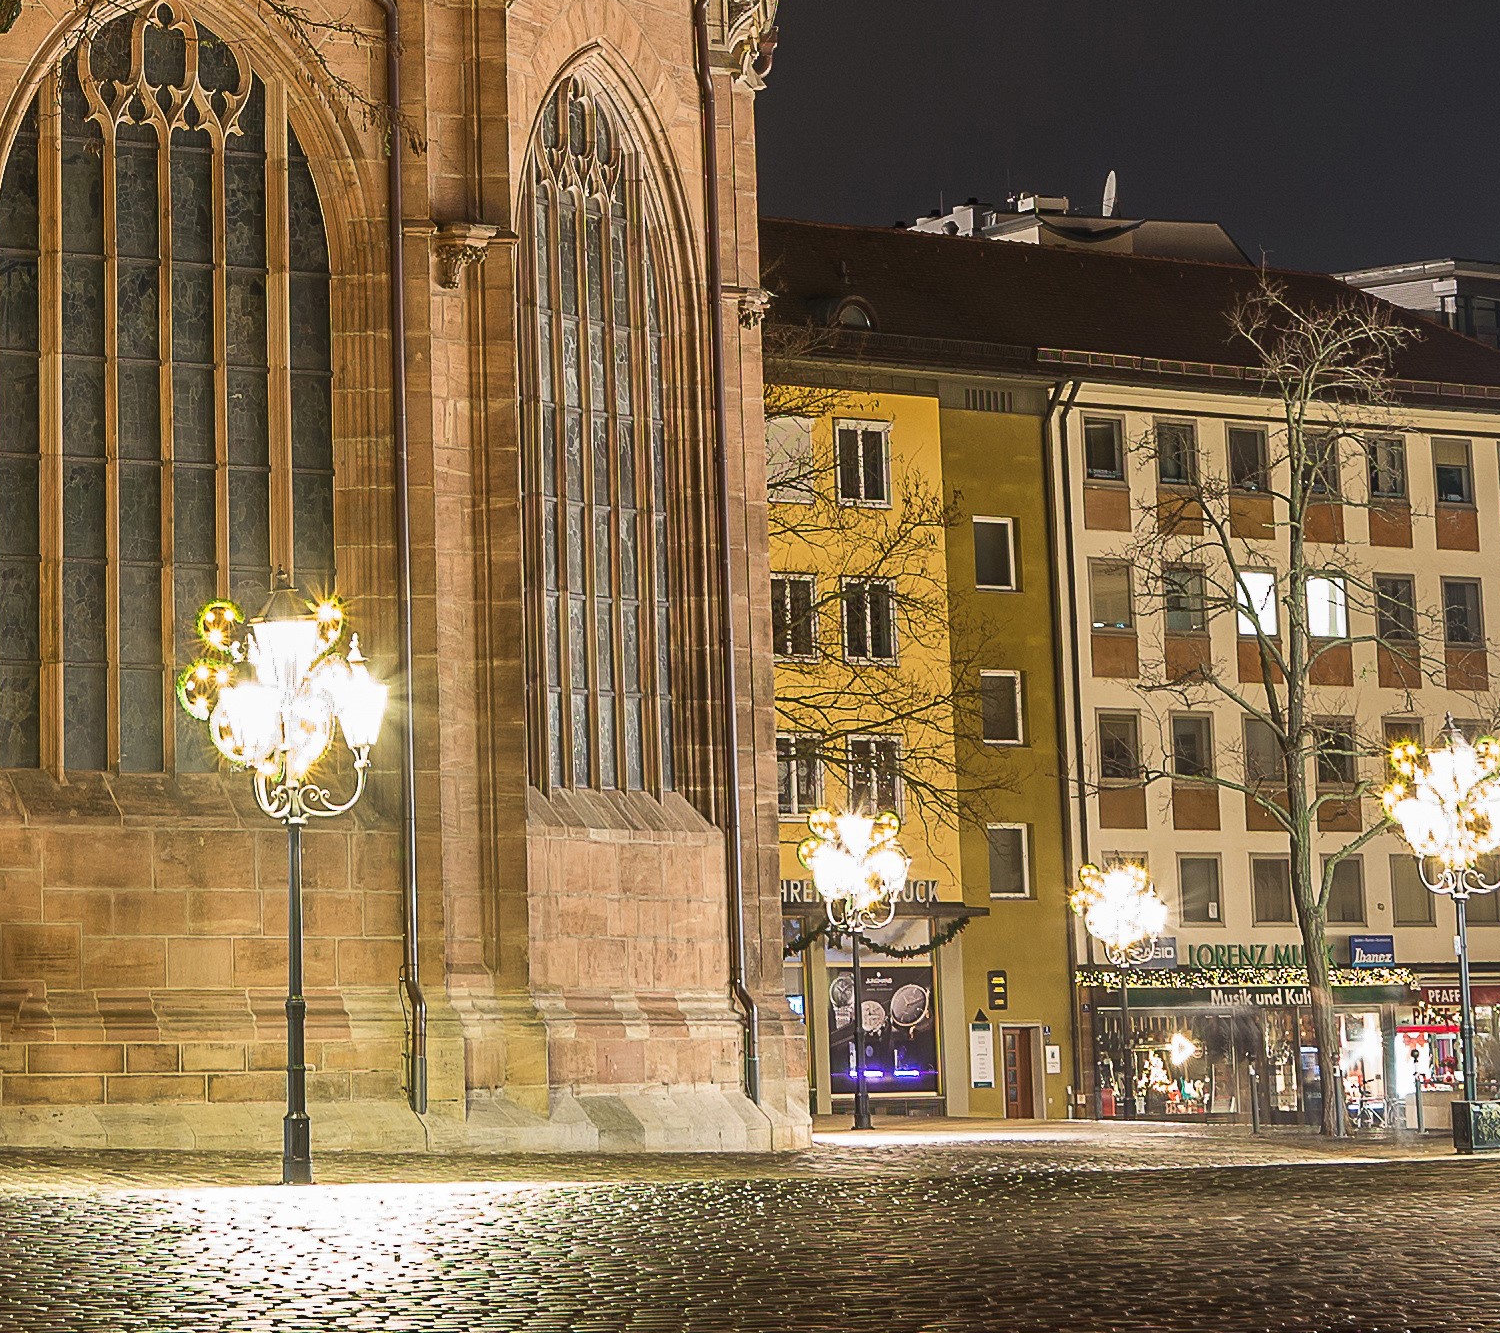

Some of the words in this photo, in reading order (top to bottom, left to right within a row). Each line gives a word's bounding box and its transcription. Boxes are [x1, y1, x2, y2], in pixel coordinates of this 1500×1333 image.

[898, 879, 940, 903] UCK
[1188, 944, 1267, 969] LORENZ
[1273, 944, 1338, 969] MUK
[1354, 947, 1393, 963] Ibanez
[1210, 988, 1253, 1006] Musik
[1256, 988, 1283, 1005] und
[1427, 989, 1461, 1003] PFAFF
